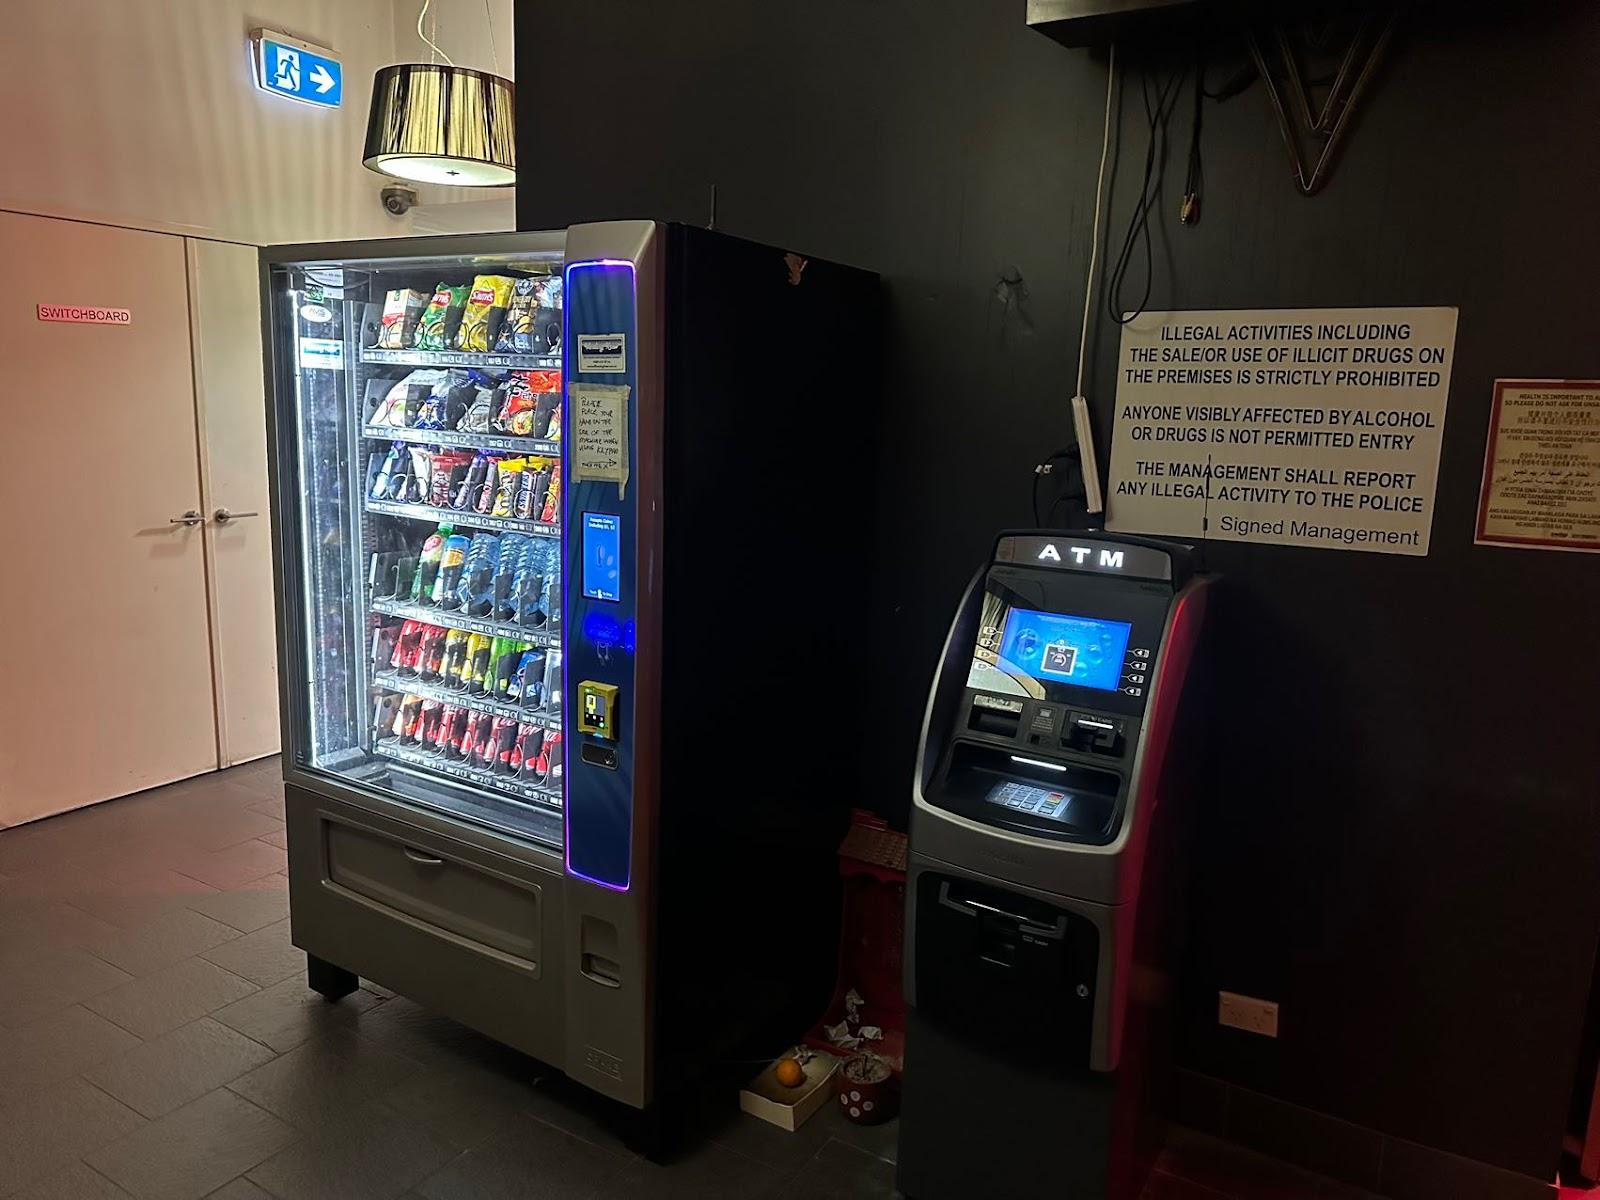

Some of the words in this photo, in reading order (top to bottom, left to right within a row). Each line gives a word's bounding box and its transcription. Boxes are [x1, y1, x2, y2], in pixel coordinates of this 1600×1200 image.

[41, 307, 129, 321] SWITCHBOARD
[1161, 326, 1224, 341] ILLEGAL
[1228, 325, 1312, 340] ACTIVITIES
[1318, 324, 1410, 339] INCLUDING
[1131, 348, 1158, 362] THE
[1162, 348, 1227, 363] SALE/OR
[1232, 348, 1262, 362] USE
[1267, 348, 1288, 363] OF
[1293, 348, 1349, 363] ILLICIT
[1353, 348, 1413, 364] DRUGS
[1419, 348, 1444, 364] ON
[1126, 370, 1152, 383] THE
[1157, 370, 1232, 384] PREMISES
[1237, 371, 1251, 384] IS
[1256, 371, 1331, 385] STRICTLY
[1336, 371, 1440, 387] PROHIBITED
[1122, 406, 1181, 420] ANYONE
[1186, 407, 1241, 422] VISIBLY
[1242, 408, 1324, 424] AFFECTED
[1329, 410, 1351, 425] BY
[1353, 411, 1435, 428] ALCOHOL
[1132, 427, 1151, 441] OR
[1156, 428, 1206, 442] DRUGS
[1211, 429, 1225, 442] IS
[1229, 429, 1260, 444] NOT
[1265, 431, 1353, 448] PERMITTED
[1359, 434, 1414, 450] ENTRY
[1136, 461, 1164, 476] THE
[1169, 462, 1280, 482] MANAGEMENT
[1285, 469, 1339, 484] SHALL
[1344, 471, 1416, 489] REPORT
[1117, 482, 1147, 496] ANY
[1152, 483, 1214, 499] ILLEGAL
[1218, 487, 1289, 504] ACTIVITY
[1294, 491, 1316, 505] TO
[1322, 492, 1354, 508] THE
[1359, 494, 1422, 512] POLICE
[1221, 516, 1284, 536] Signed
[1290, 520, 1419, 545] Management
[1038, 544, 1124, 568] ATM
